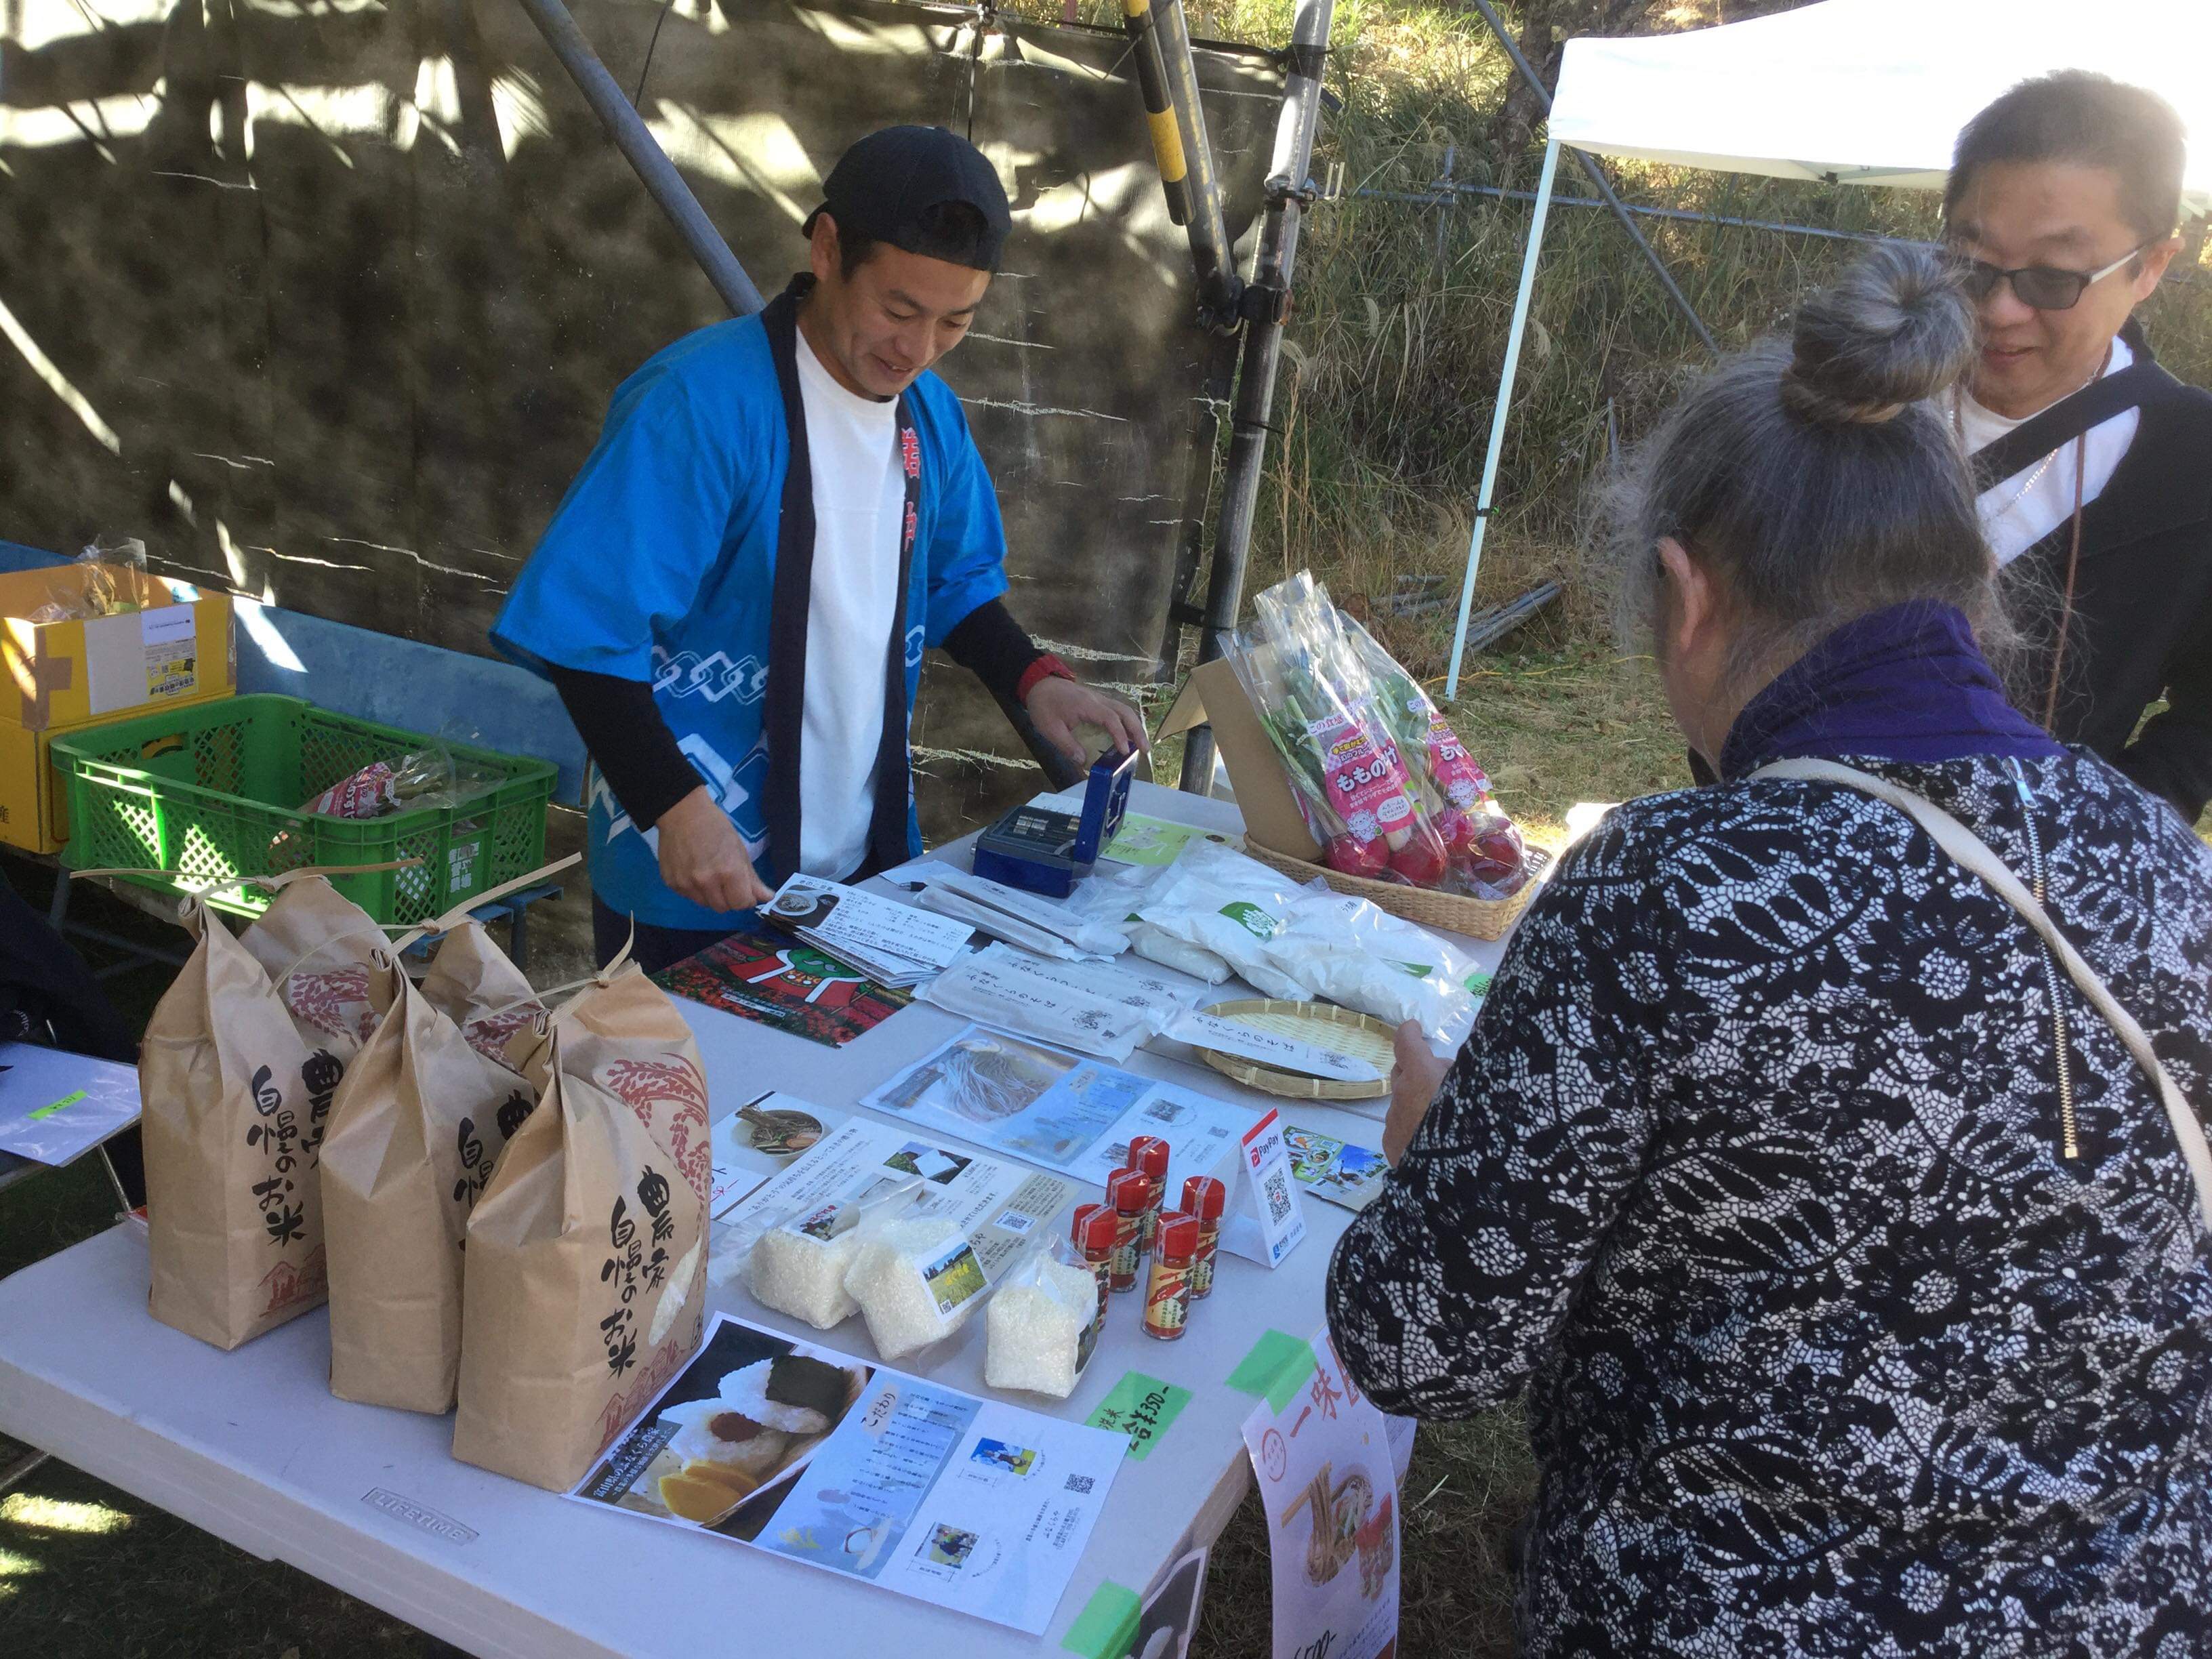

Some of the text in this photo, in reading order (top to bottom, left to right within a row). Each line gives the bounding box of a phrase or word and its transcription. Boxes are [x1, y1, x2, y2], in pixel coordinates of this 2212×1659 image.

[247, 1065, 307, 1248] 自慢のお米
[1258, 1134, 1278, 1156] PayPay
[637, 1164, 674, 1294] 農家
[600, 1195, 642, 1380] 自慢のお米
[861, 1391, 898, 1428] こだわり
[374, 1494, 464, 1540] LIFETIME
